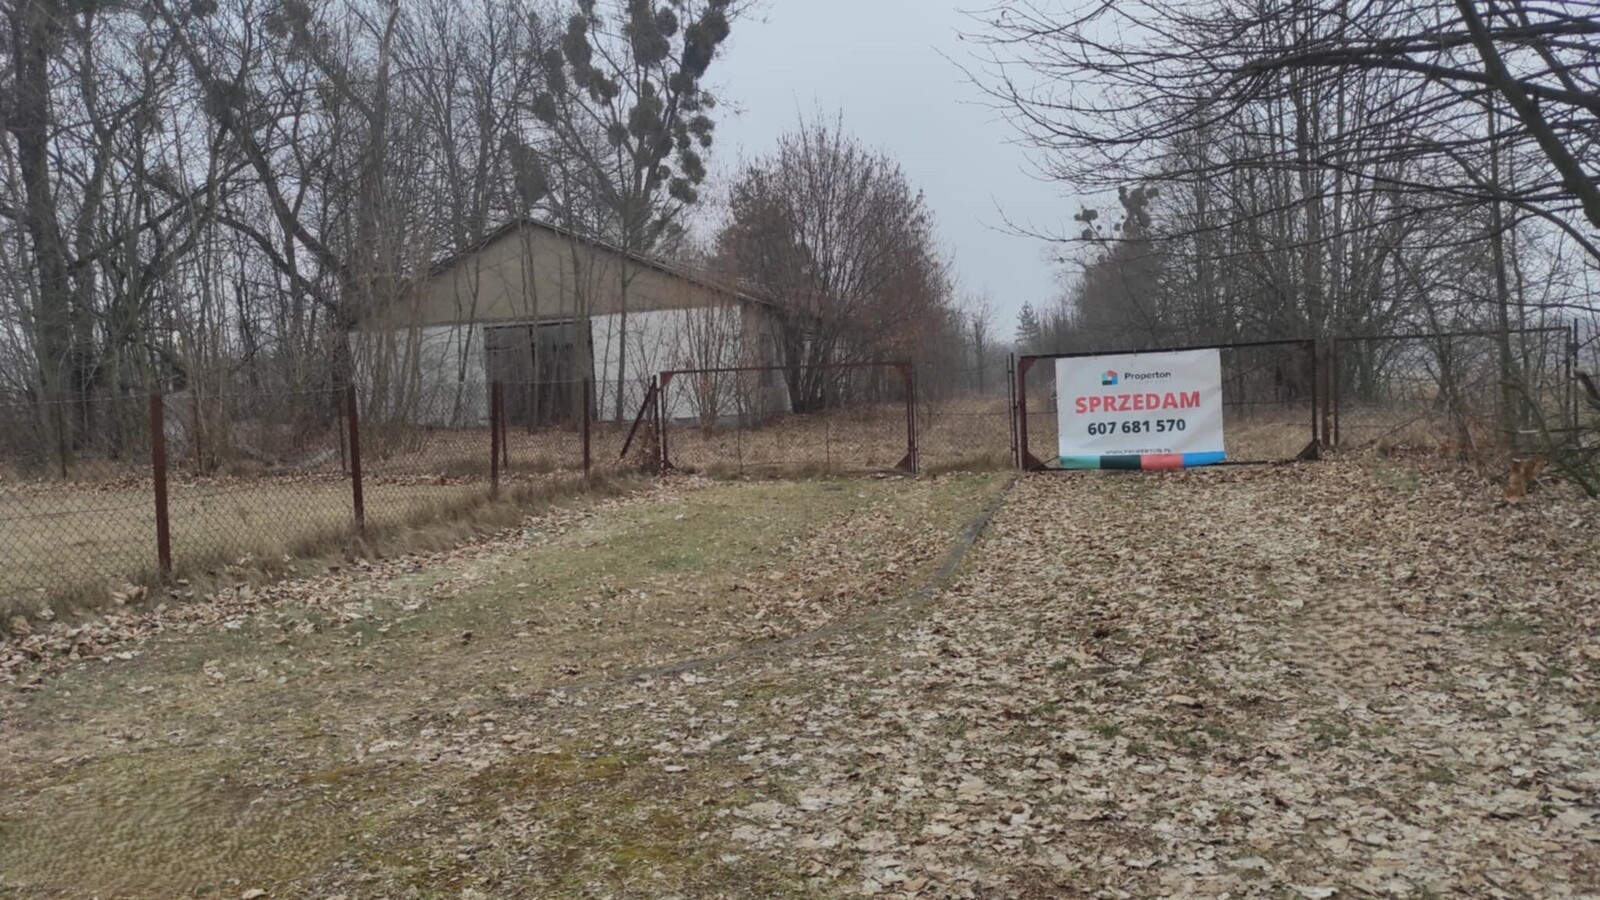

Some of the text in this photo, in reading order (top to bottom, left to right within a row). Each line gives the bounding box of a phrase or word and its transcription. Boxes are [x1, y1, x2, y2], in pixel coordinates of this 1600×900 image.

[1124, 371, 1171, 380] Properton
[1075, 391, 1200, 413] SPRZEDAM
[1087, 419, 1186, 435] 607 681 570
